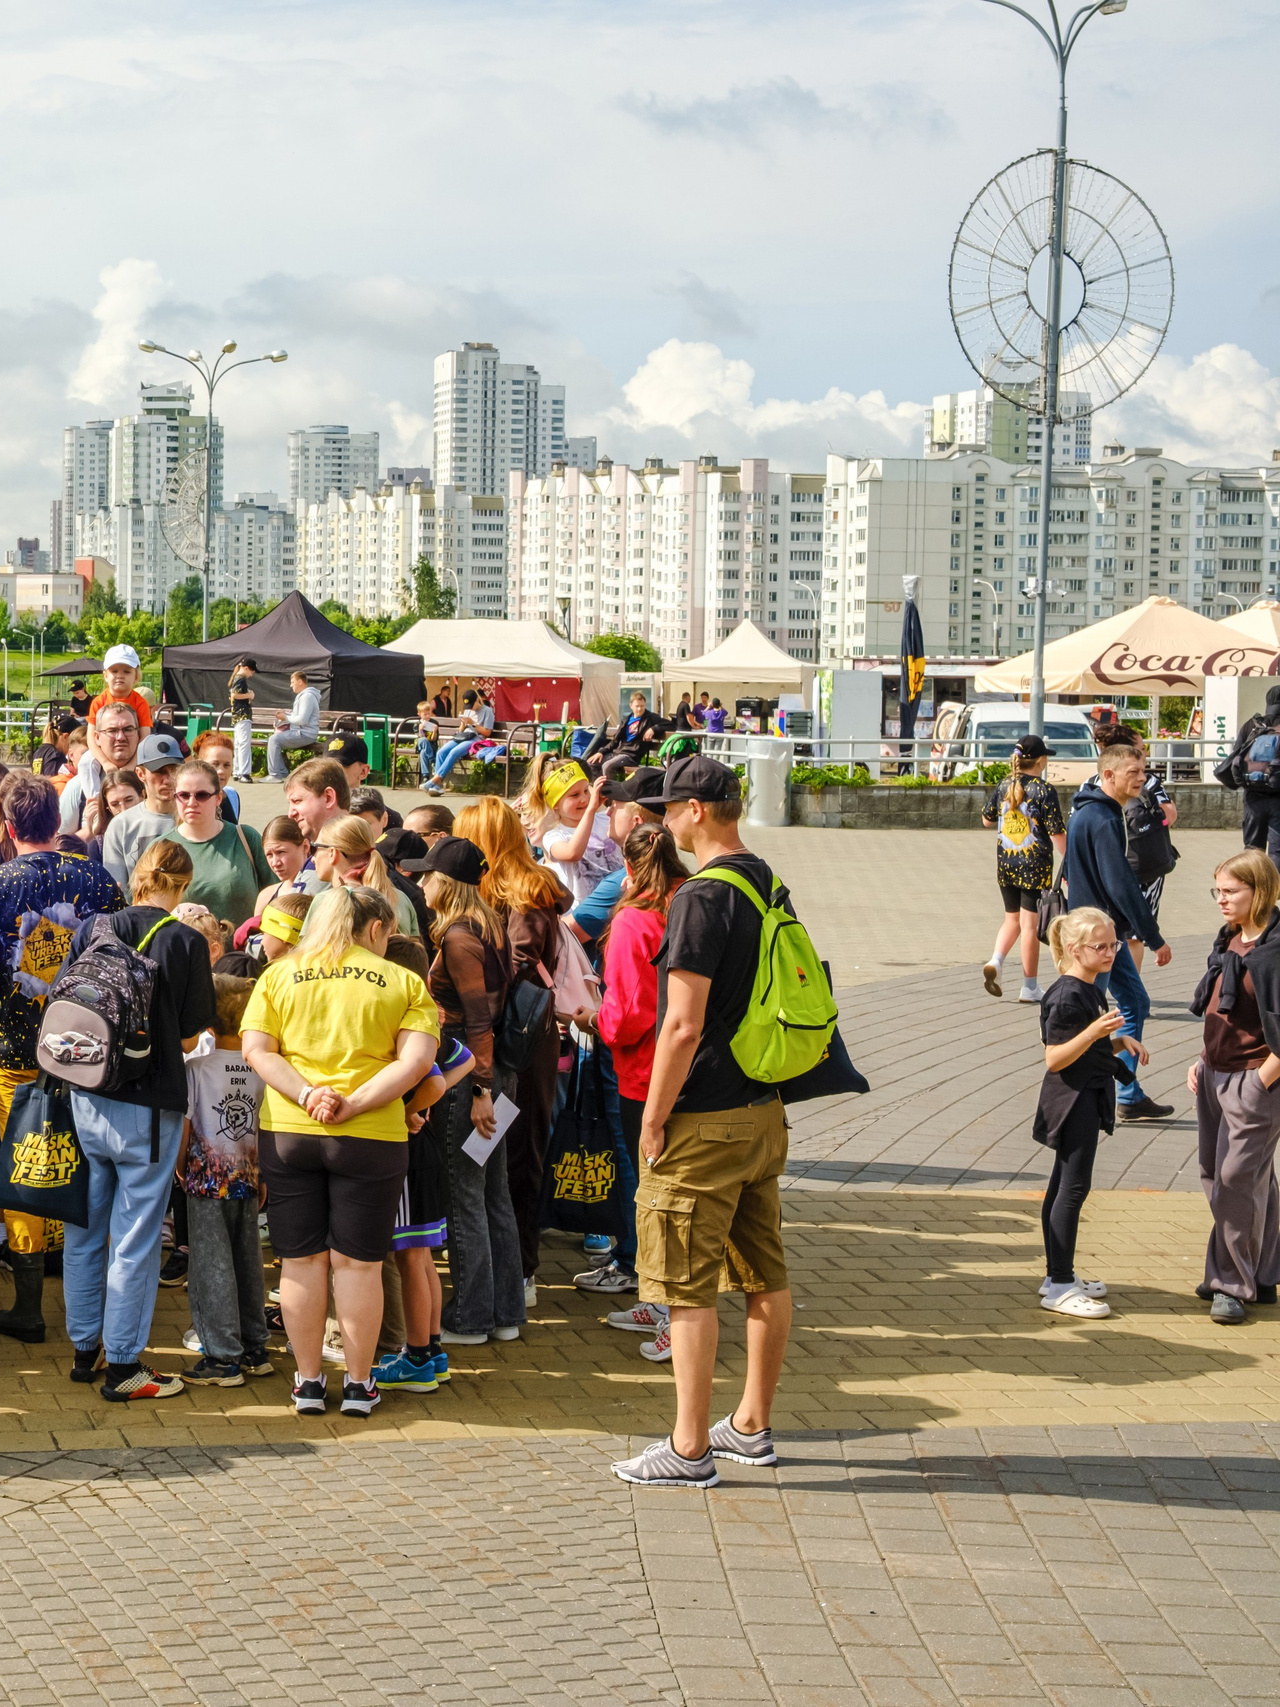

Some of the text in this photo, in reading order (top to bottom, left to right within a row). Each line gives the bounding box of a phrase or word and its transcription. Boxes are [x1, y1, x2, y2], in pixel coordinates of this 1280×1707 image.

[293, 966, 387, 988] БЕЛАРУСЬ
[225, 1065, 252, 1073] BARAN
[230, 1077, 247, 1085] ERIK
[16, 1146, 76, 1165] URBAN
[562, 1152, 608, 1171] MISK
[15, 1162, 70, 1181] FEST
[559, 1179, 607, 1197] FEST
